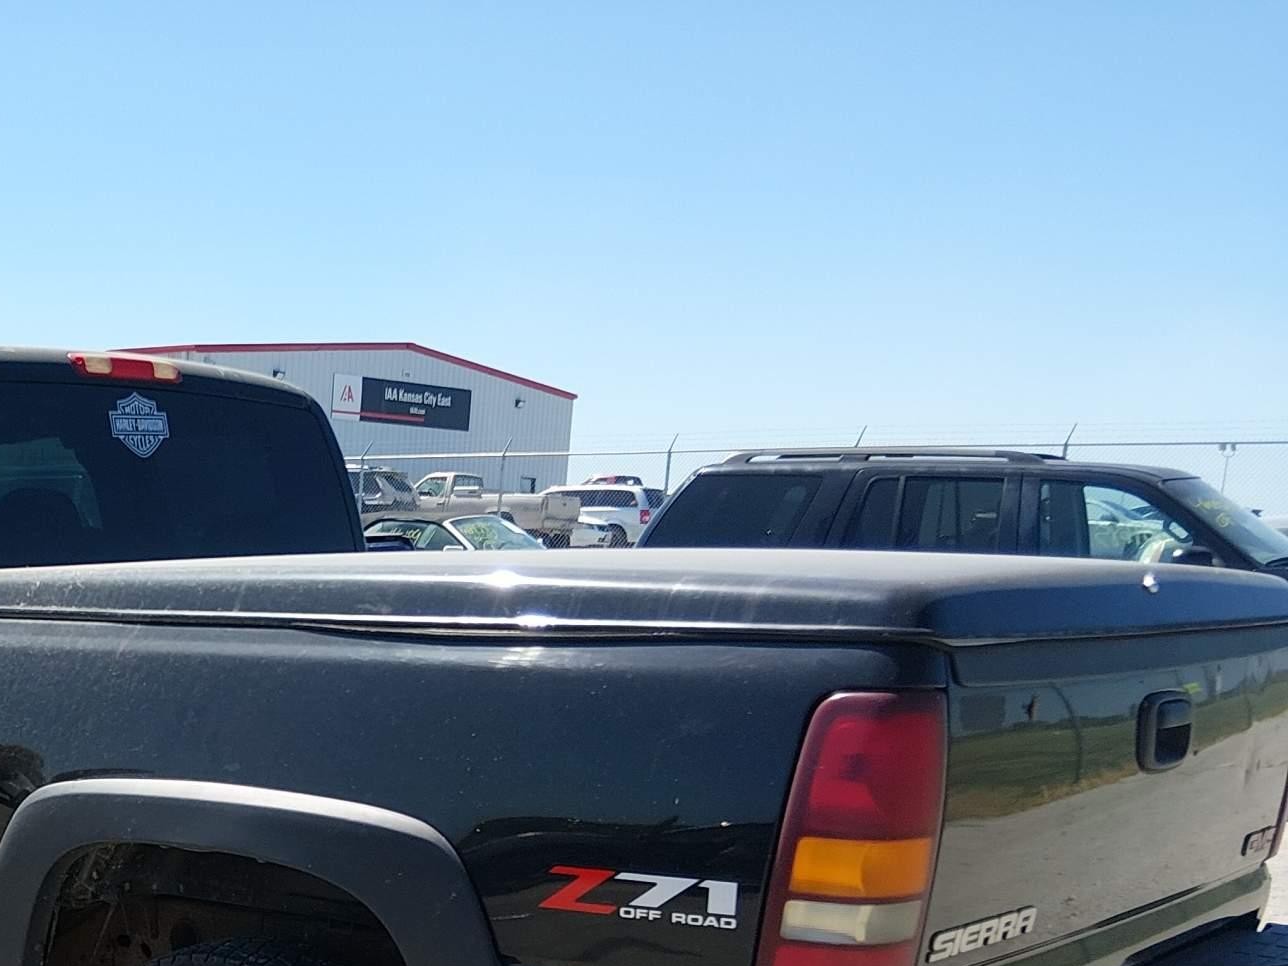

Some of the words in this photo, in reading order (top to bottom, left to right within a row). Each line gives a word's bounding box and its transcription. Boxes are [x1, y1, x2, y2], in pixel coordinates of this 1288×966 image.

[384, 386, 398, 401] IAA
[398, 388, 423, 404] Kansas
[423, 391, 437, 407] City
[437, 393, 451, 407] East
[537, 865, 739, 916] Z71
[619, 906, 662, 921] OFF
[671, 912, 737, 930] ROAD
[926, 905, 1038, 963] SIERRA
